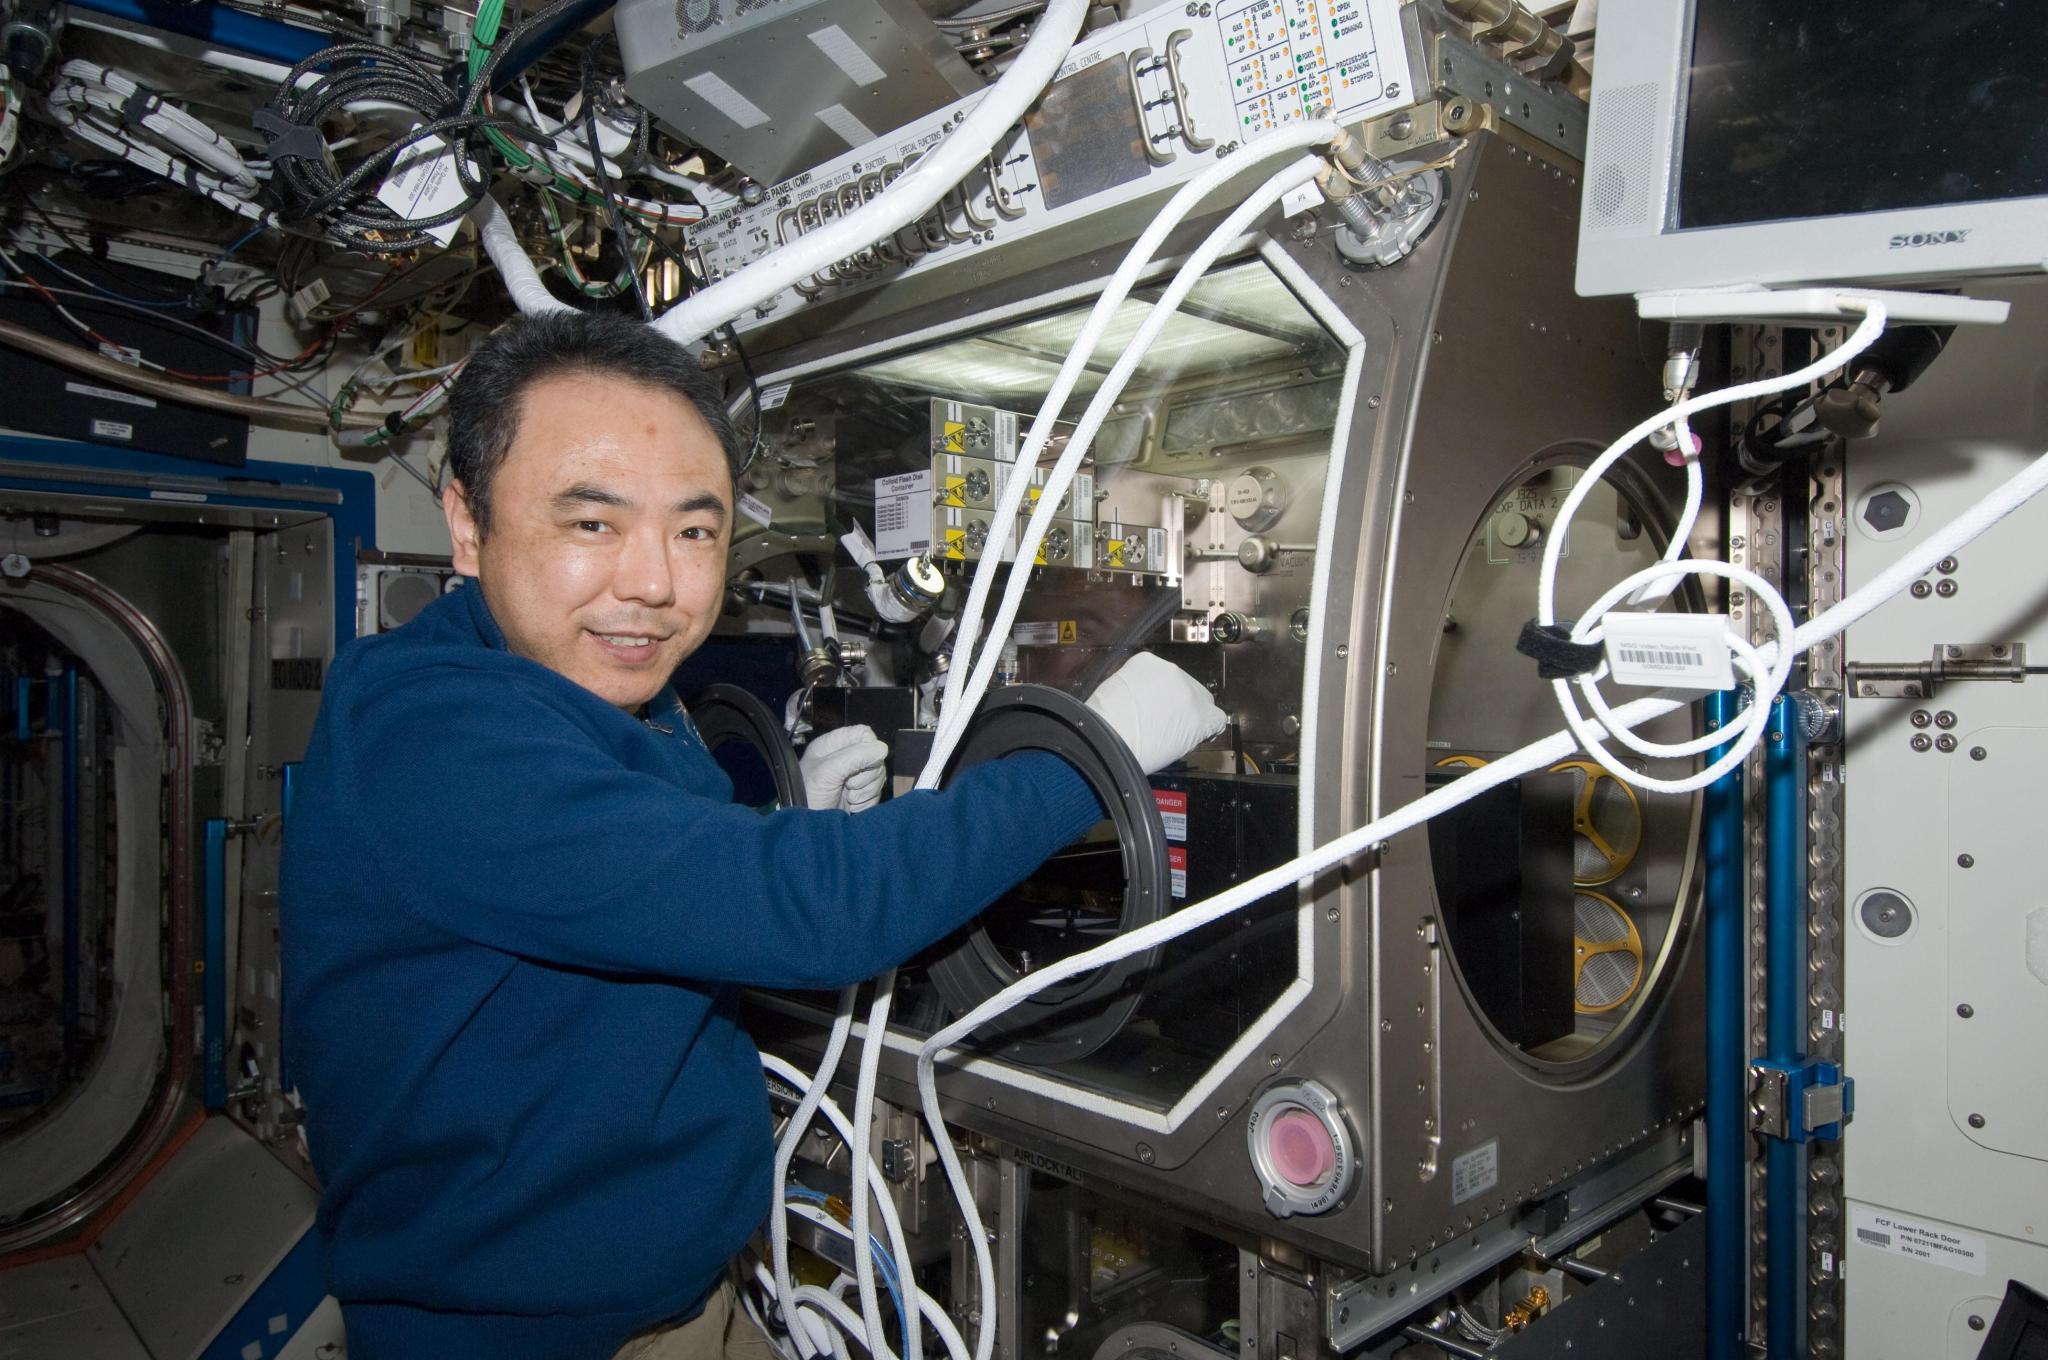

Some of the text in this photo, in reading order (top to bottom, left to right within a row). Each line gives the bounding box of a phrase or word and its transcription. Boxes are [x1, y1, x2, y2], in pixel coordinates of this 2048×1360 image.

[689, 214, 719, 235] COMMAND
[720, 209, 732, 221] AND
[771, 183, 793, 200] PANEL
[1888, 229, 1973, 249] SONY
[1520, 500, 1546, 511] DATA
[1551, 497, 1558, 509] 2
[1014, 1148, 1060, 1174] AIRLOCK
[1875, 1218, 1961, 1245] FCF Lower Rack Door
[1901, 1246, 1913, 1254] S/N
